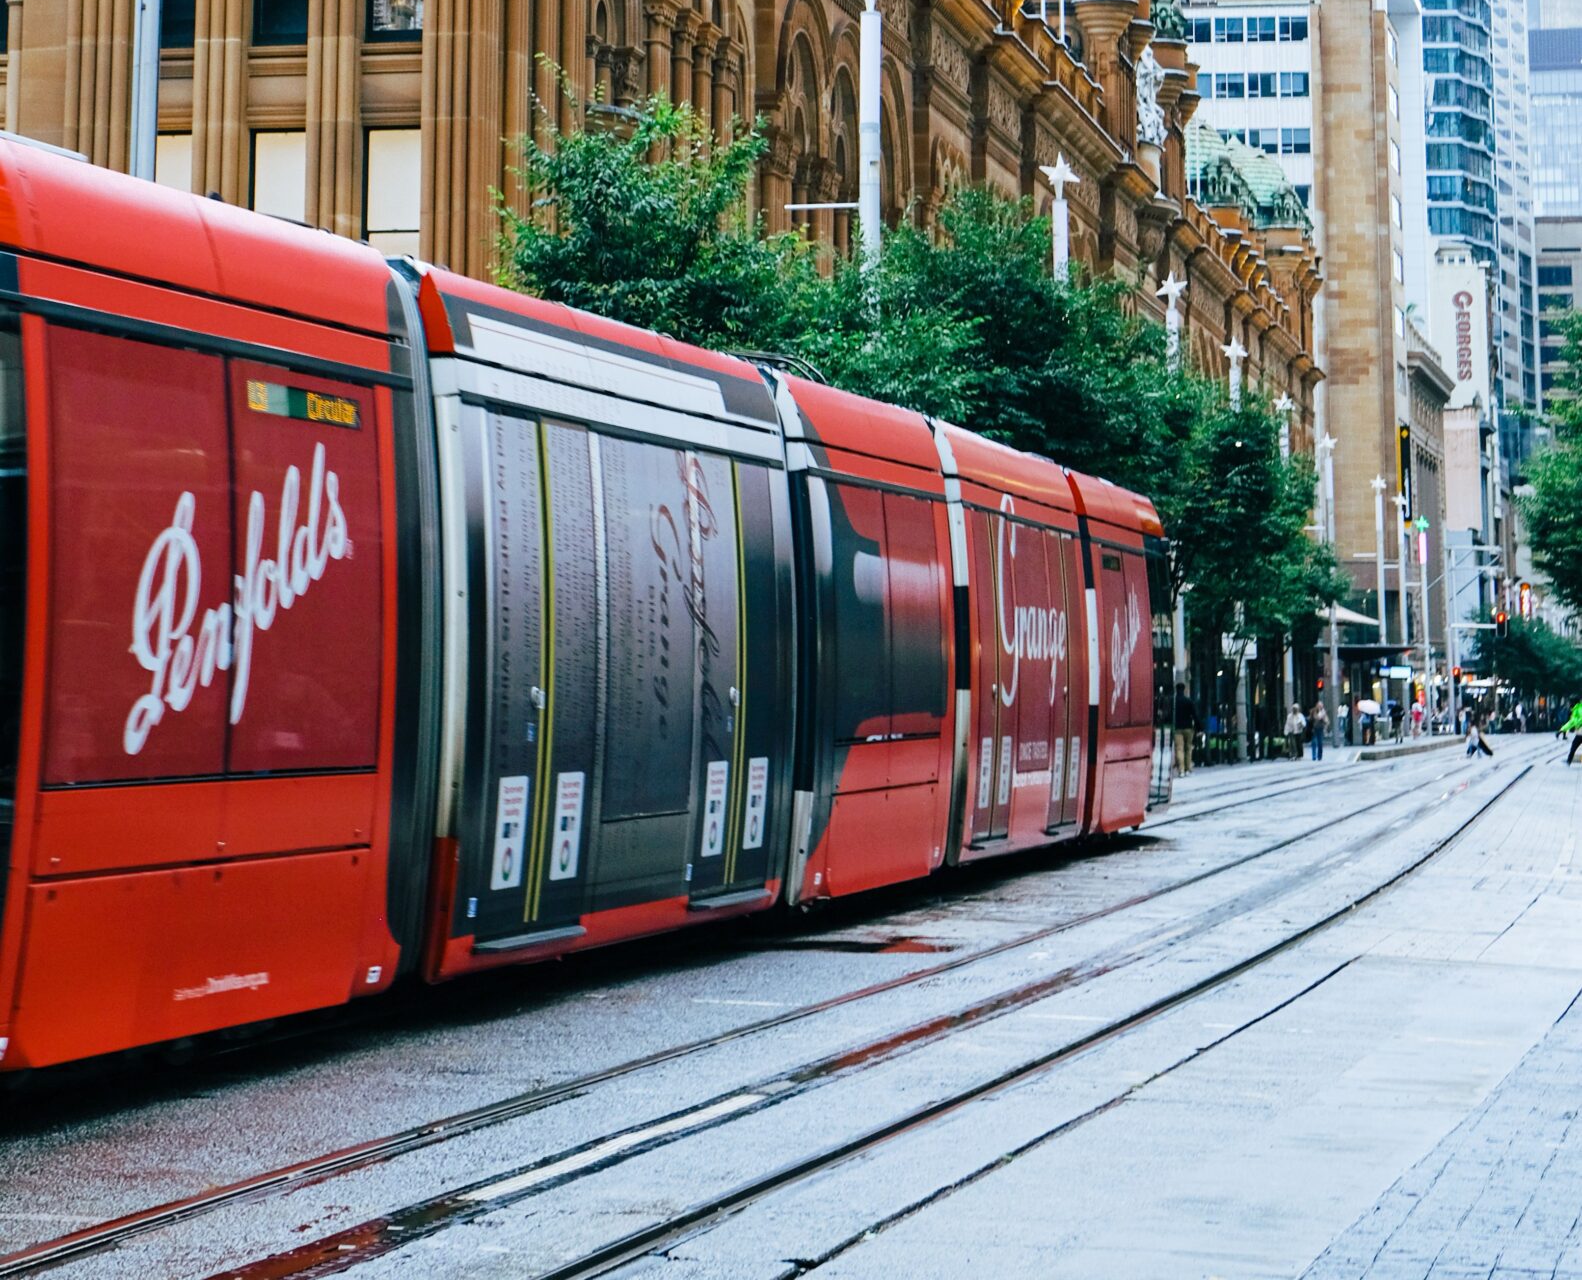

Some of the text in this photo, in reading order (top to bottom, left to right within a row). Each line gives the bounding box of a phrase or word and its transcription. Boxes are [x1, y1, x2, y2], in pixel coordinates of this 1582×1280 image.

[1452, 291, 1473, 382] GEORGES
[123, 441, 348, 756] Penfolds
[998, 493, 1066, 707] Grange
